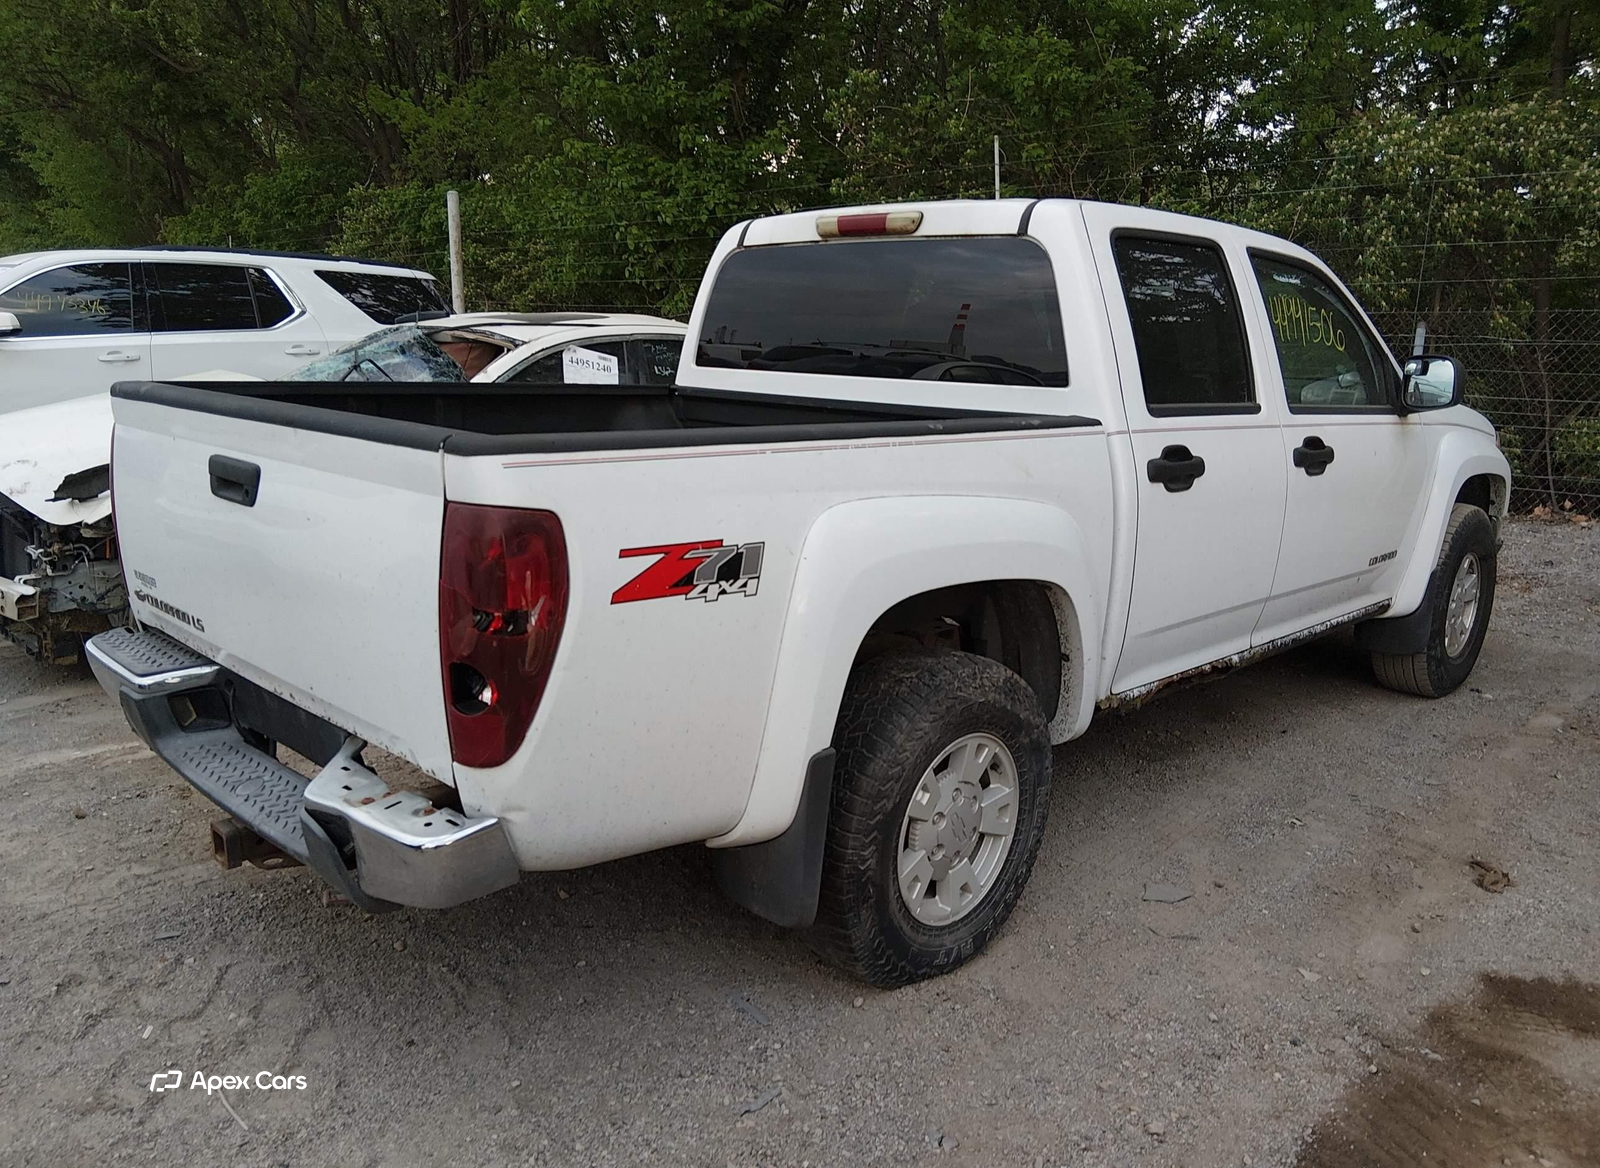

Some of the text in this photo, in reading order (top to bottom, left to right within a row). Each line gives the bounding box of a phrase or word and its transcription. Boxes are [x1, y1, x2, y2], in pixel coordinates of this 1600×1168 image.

[1268, 293, 1346, 352] 44941506
[568, 356, 612, 374] 44951240
[1368, 549, 1398, 566] COLORADO
[610, 539, 765, 605] Z71
[191, 614, 206, 633] LS
